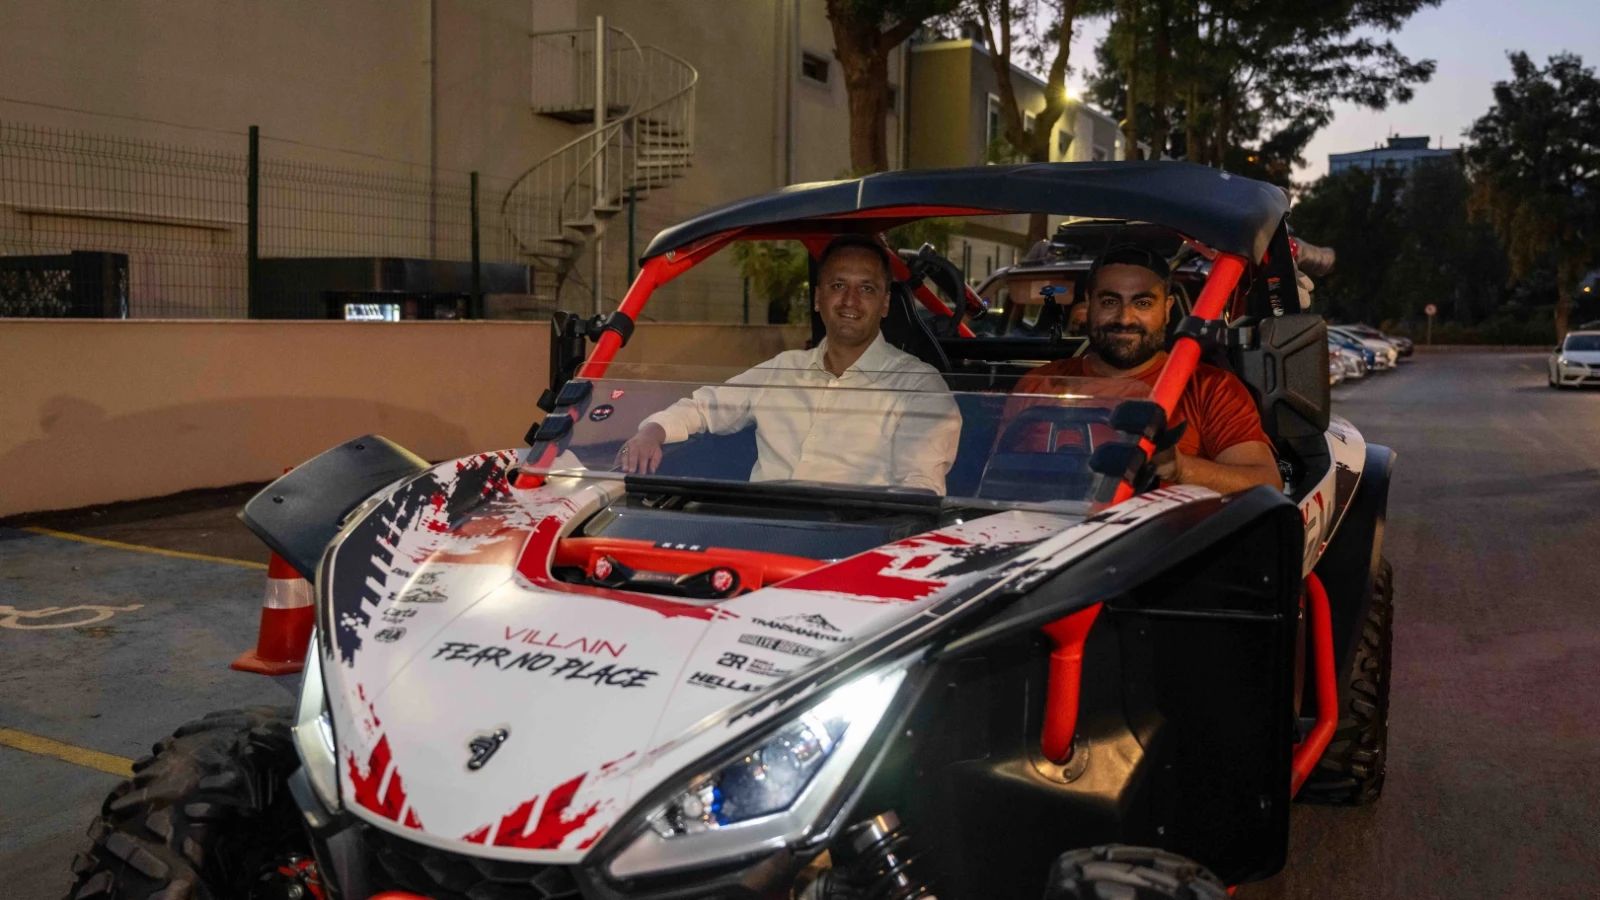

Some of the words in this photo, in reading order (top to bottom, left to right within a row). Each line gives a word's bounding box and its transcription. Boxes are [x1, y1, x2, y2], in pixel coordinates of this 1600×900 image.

[504, 626, 628, 658] VILLAIN
[432, 642, 511, 667] FEAR
[501, 650, 555, 672] NO
[551, 657, 658, 688] PLACE
[716, 652, 749, 670] 2R
